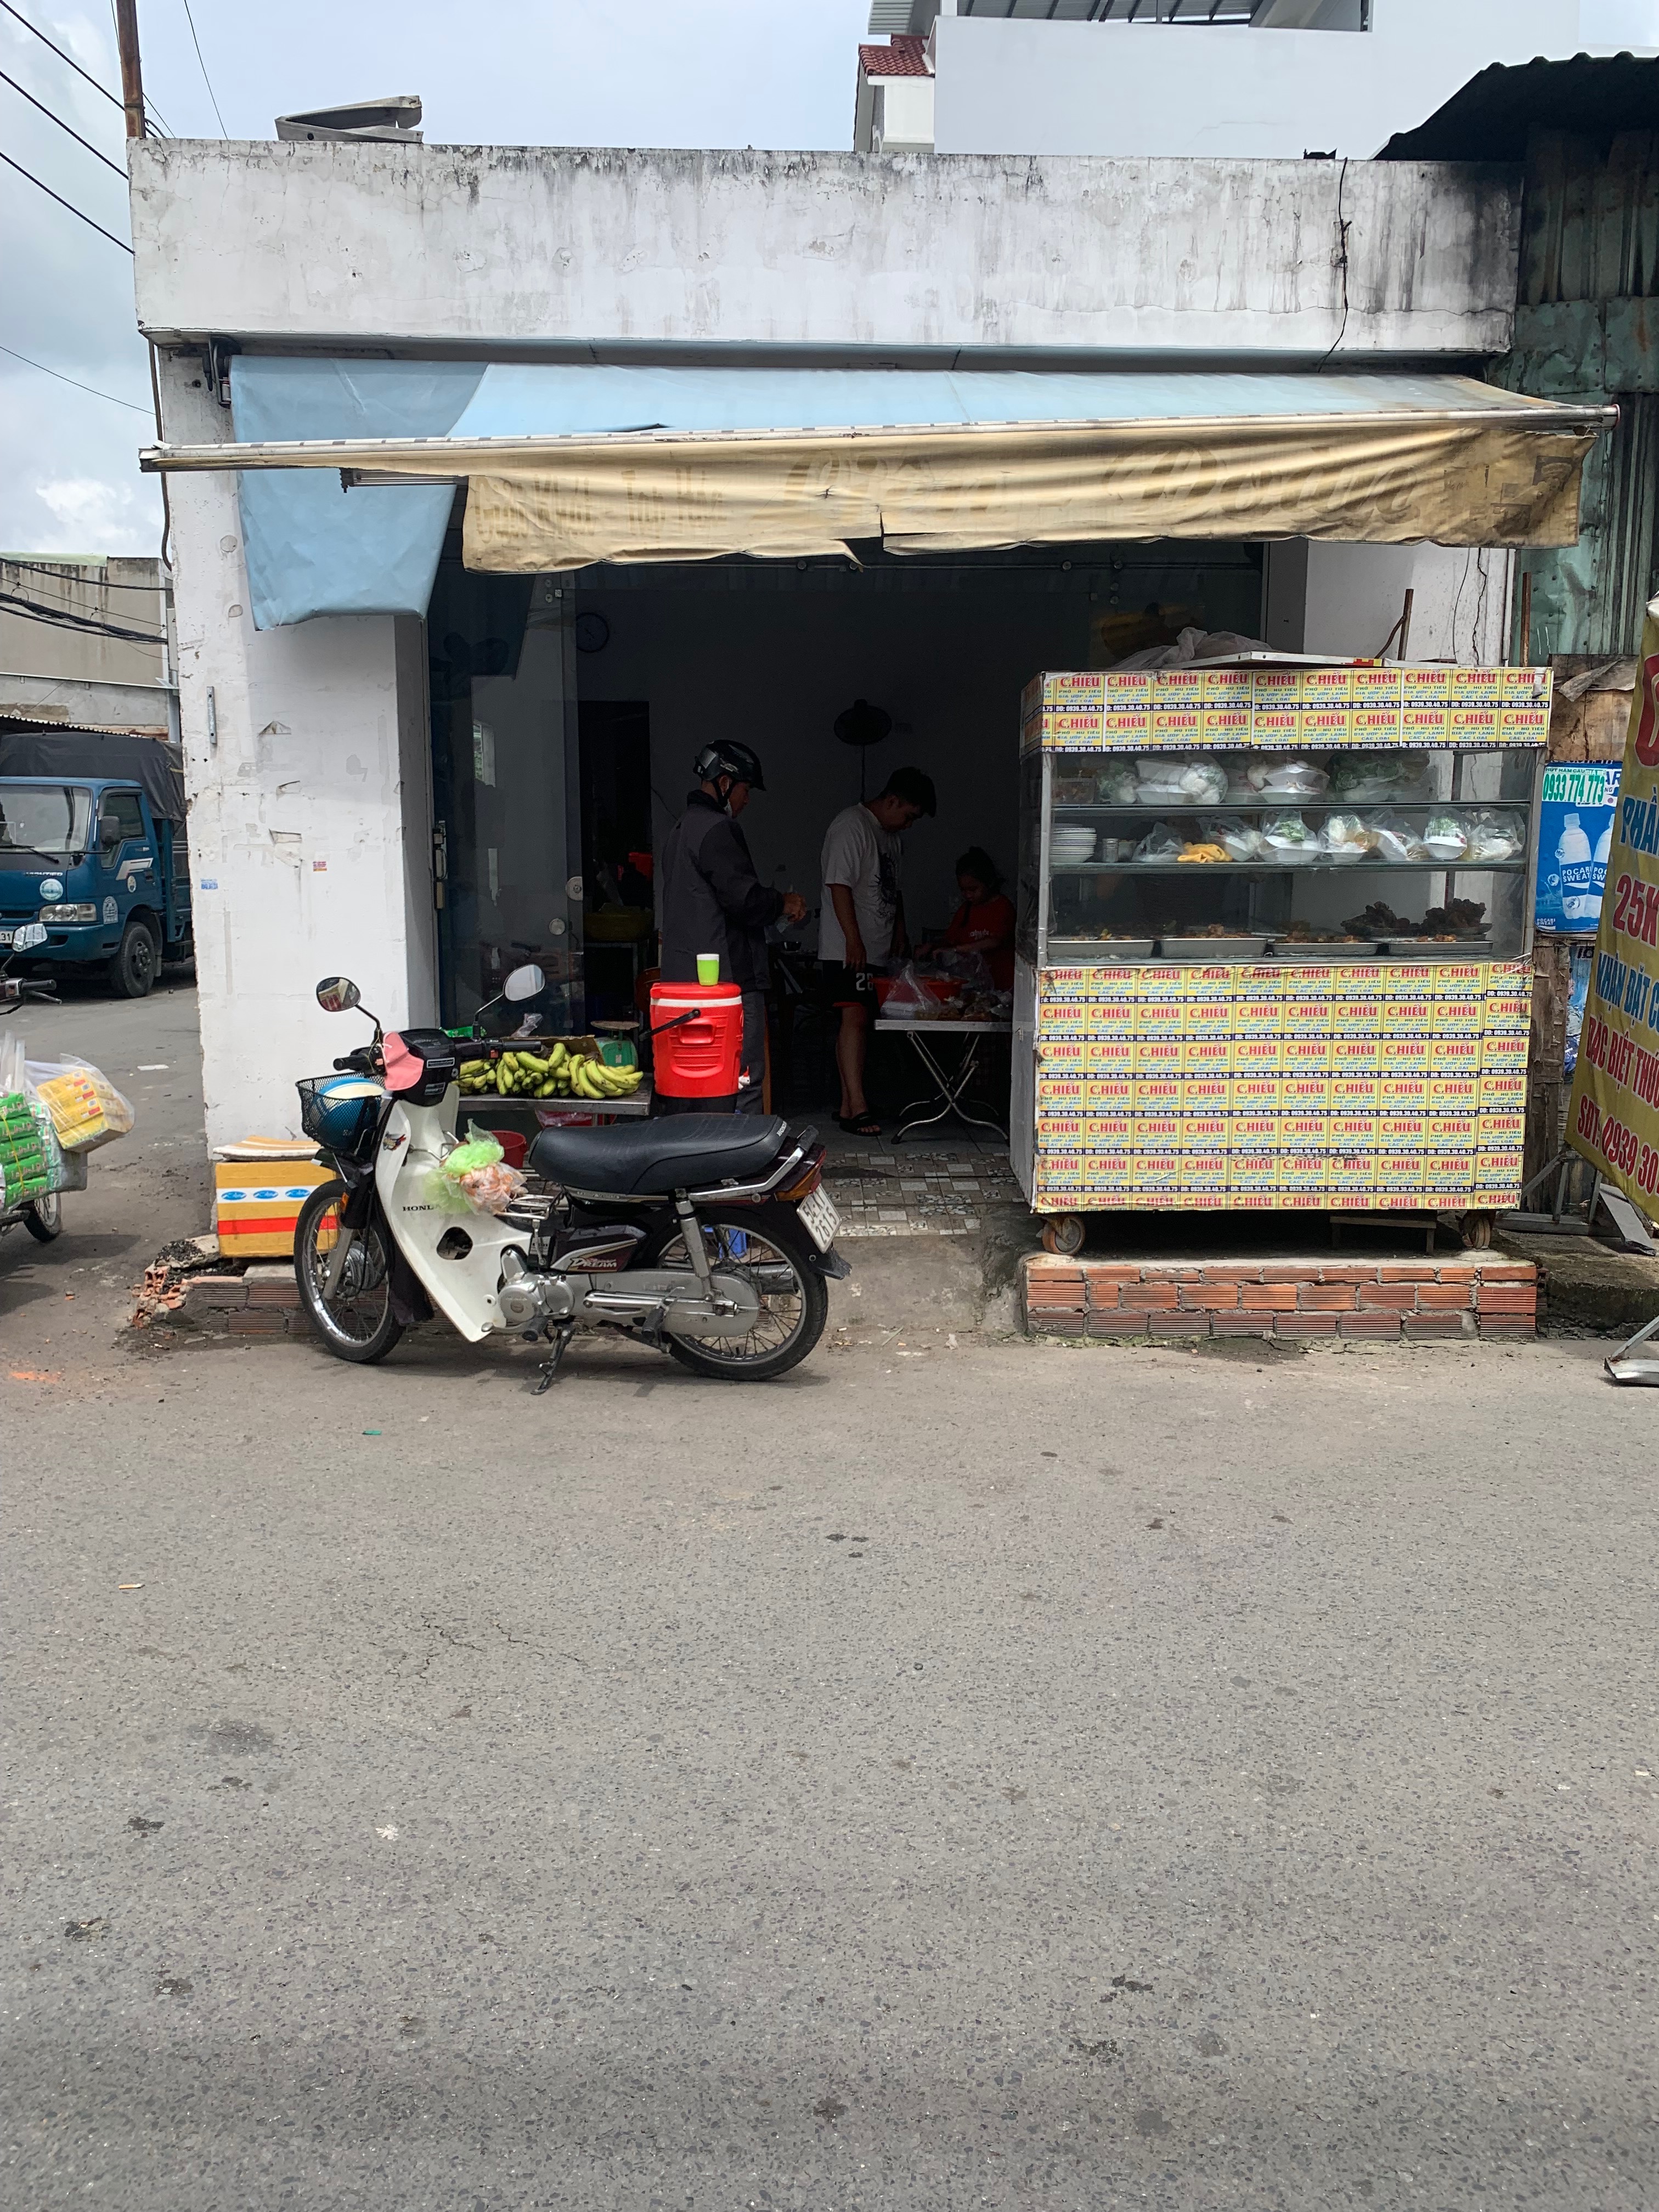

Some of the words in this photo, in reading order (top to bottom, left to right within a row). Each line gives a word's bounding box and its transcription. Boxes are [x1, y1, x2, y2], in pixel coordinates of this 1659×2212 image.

[1060, 674, 1101, 688] C.HIẾU
[1107, 673, 1148, 687] C.HIẾU
[1157, 672, 1199, 686] C.HIẾU
[1207, 670, 1249, 685] C.HIẾU
[1256, 672, 1297, 686] C.HIẾU
[1306, 671, 1347, 685] C.HIẾU
[1357, 670, 1398, 685] C.HIẾU
[1406, 670, 1446, 684] C.HIẾU
[1456, 670, 1497, 684] C.HIẾU
[1059, 715, 1099, 729] C.HIẾU
[1106, 713, 1147, 728] C.HIẾU
[1156, 712, 1198, 727] C.HIẾU
[1207, 711, 1248, 726] C.HIẾU
[1255, 713, 1296, 727] C.HIẾU
[1305, 712, 1346, 726] C.HIẾU
[1356, 711, 1396, 725] C.HIẾU
[1403, 710, 1444, 724] C.HIẾU
[1454, 710, 1494, 724] C.HIẾU
[1504, 711, 1544, 725] C.HIẾU
[1563, 873, 1590, 882] SWEAT
[1042, 1006, 1082, 1018] C.HIẾU
[1091, 1005, 1131, 1018] C.HIẾU
[1141, 1005, 1181, 1018] C.HIẾU
[1189, 1005, 1229, 1018] C.HIẾU
[1239, 1004, 1279, 1017] C.HIẾU
[1288, 1004, 1329, 1017] C.HIẾU
[1338, 1003, 1378, 1017] C.HIẾU
[1387, 1003, 1428, 1017] C.HIẾU
[1437, 1003, 1477, 1017] C.HIẾU
[1489, 1000, 1528, 1013] C.HIẾU
[1042, 1043, 1081, 1057] C.HIẾU
[1090, 1043, 1131, 1057] C.HIẾU
[1139, 1044, 1180, 1057] C.HIẾU
[1188, 1043, 1228, 1057] C.HIẾU
[1238, 1042, 1278, 1056] C.HIẾU
[1286, 1042, 1327, 1055] C.HIẾU
[1336, 1042, 1376, 1055] C.HIẾU
[1385, 1042, 1426, 1055] C.HIẾU
[1435, 1042, 1475, 1055] C.HIẾU
[1486, 1039, 1526, 1052] C.HIẾU
[1607, 1031, 1635, 1090] BIỆT
[1041, 1082, 1081, 1095] C.HIẾU
[1090, 1082, 1130, 1095] C.HIẾU
[1138, 1082, 1178, 1095] C.HIẾU
[1187, 1081, 1226, 1094] C.HIẾU
[1237, 1081, 1276, 1094] C.HIẾU
[1285, 1081, 1325, 1093] C.HIẾU
[1334, 1080, 1375, 1093] C.HIẾU
[1384, 1080, 1424, 1093] C.HIẾU
[1433, 1081, 1474, 1094] C.HIẾU
[1484, 1077, 1523, 1091] C.HIẾU
[1041, 1120, 1080, 1132] C.HIẾU
[1088, 1120, 1128, 1132] C.HIẾU
[1137, 1120, 1177, 1132] C.HIẾU
[1186, 1120, 1225, 1132] C.HIẾU
[1235, 1119, 1275, 1132] C.HIẾU
[1284, 1119, 1324, 1132] C.HIẾU
[1333, 1119, 1373, 1132] C.HIẾU
[1383, 1119, 1423, 1132] C.HIẾU
[1432, 1119, 1471, 1132] C.HIẾU
[1482, 1116, 1521, 1129] C.HIẾU
[1602, 1116, 1639, 1176] 0939
[1041, 1157, 1079, 1170] C.HIẾU
[1088, 1157, 1127, 1170] C.HIẾU
[1136, 1158, 1176, 1170] C.HIẾU
[1184, 1158, 1224, 1170] C.HIẾU
[1234, 1157, 1274, 1170] C.HIẾU
[1283, 1157, 1323, 1170] C.HIẾU
[1332, 1157, 1372, 1170] C.HIẾU
[1381, 1158, 1421, 1170] C.HIẾU
[1430, 1158, 1470, 1170] C.HIẾU
[1480, 1154, 1519, 1167] C.HIẾU
